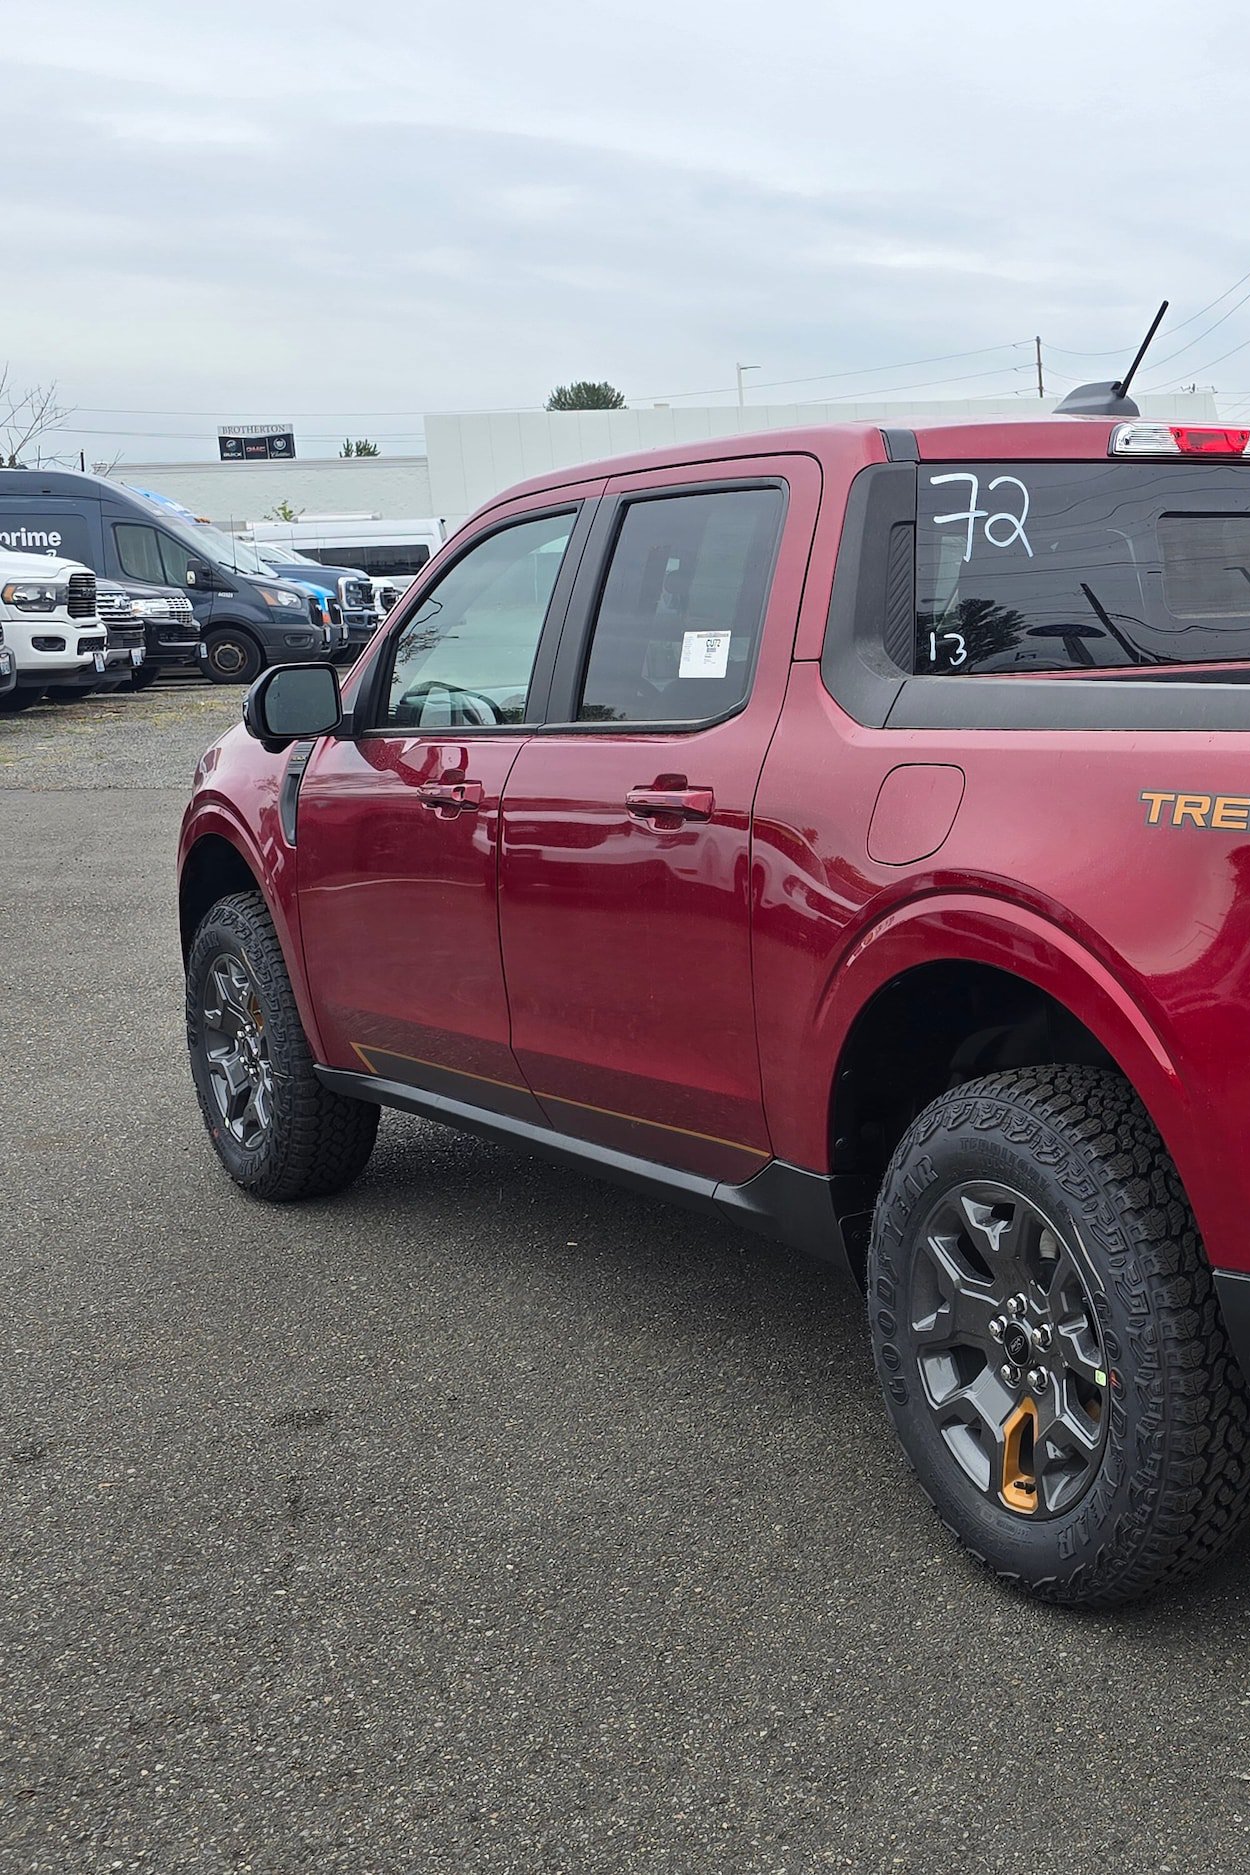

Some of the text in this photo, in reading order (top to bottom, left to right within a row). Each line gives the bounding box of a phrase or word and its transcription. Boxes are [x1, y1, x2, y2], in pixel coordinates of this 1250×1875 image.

[222, 425, 286, 434] BROTHERTON
[930, 472, 1034, 562] 72
[929, 631, 968, 666] 13
